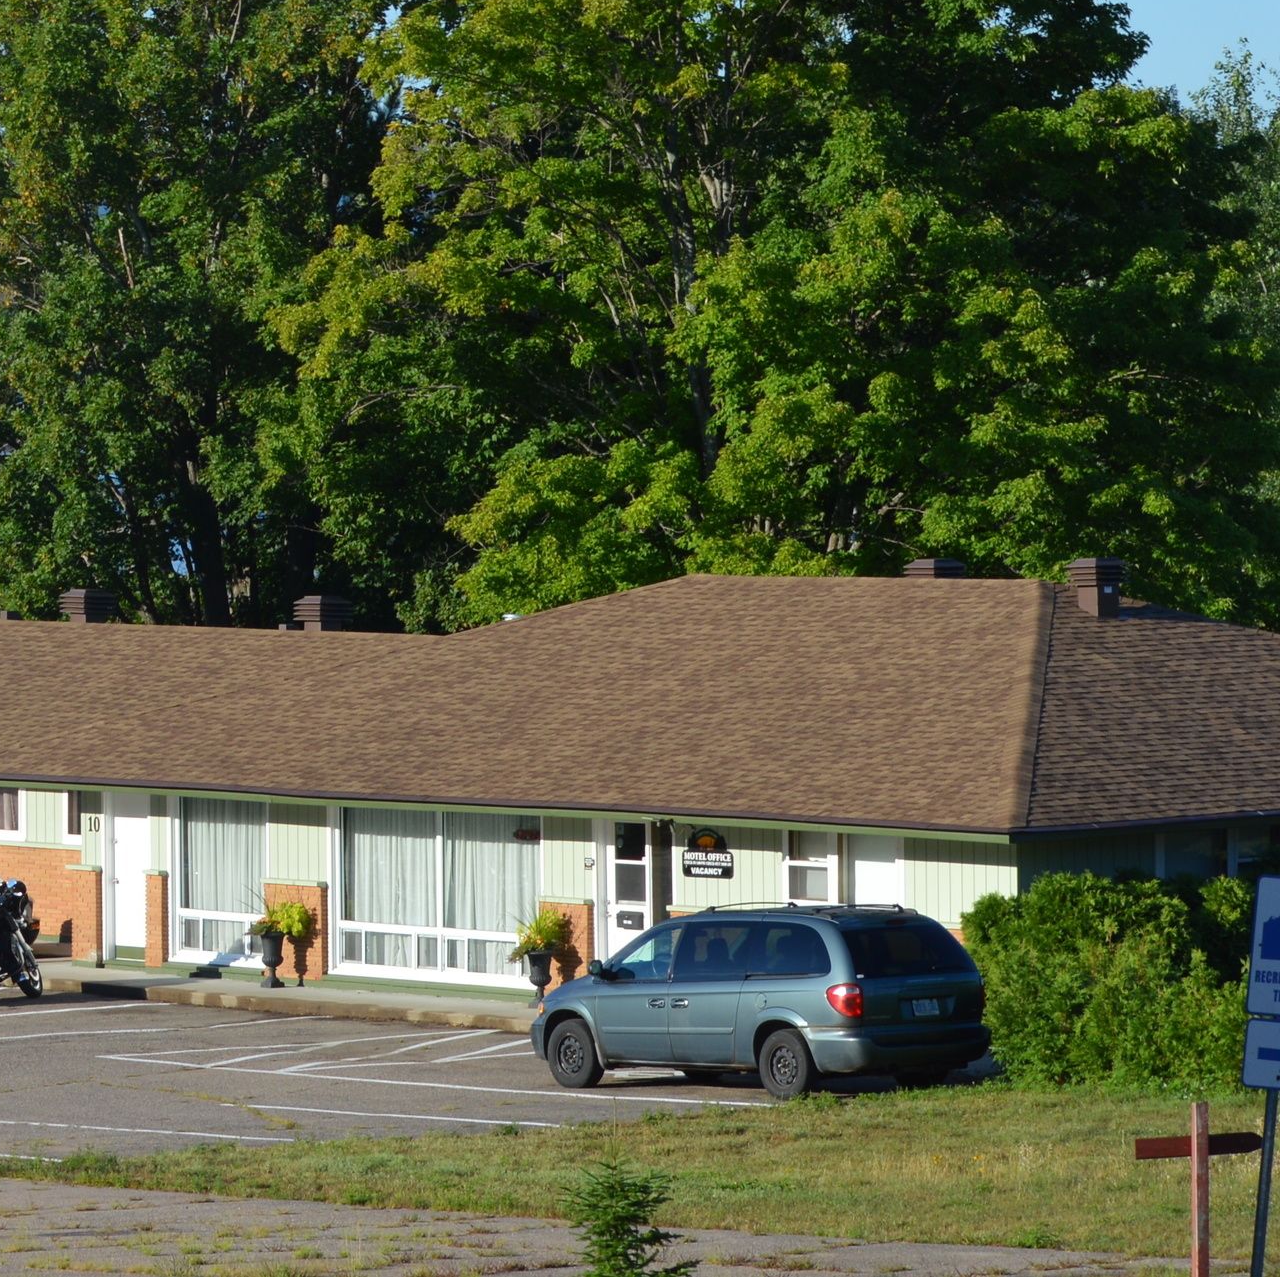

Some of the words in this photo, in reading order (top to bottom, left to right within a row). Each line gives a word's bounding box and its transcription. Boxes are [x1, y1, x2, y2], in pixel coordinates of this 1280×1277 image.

[87, 816, 101, 833] 10
[683, 851, 707, 861] MOTEL
[707, 852, 732, 862] OFFICE
[690, 867, 723, 875] VACANCY
[1273, 989, 1280, 1003] T
